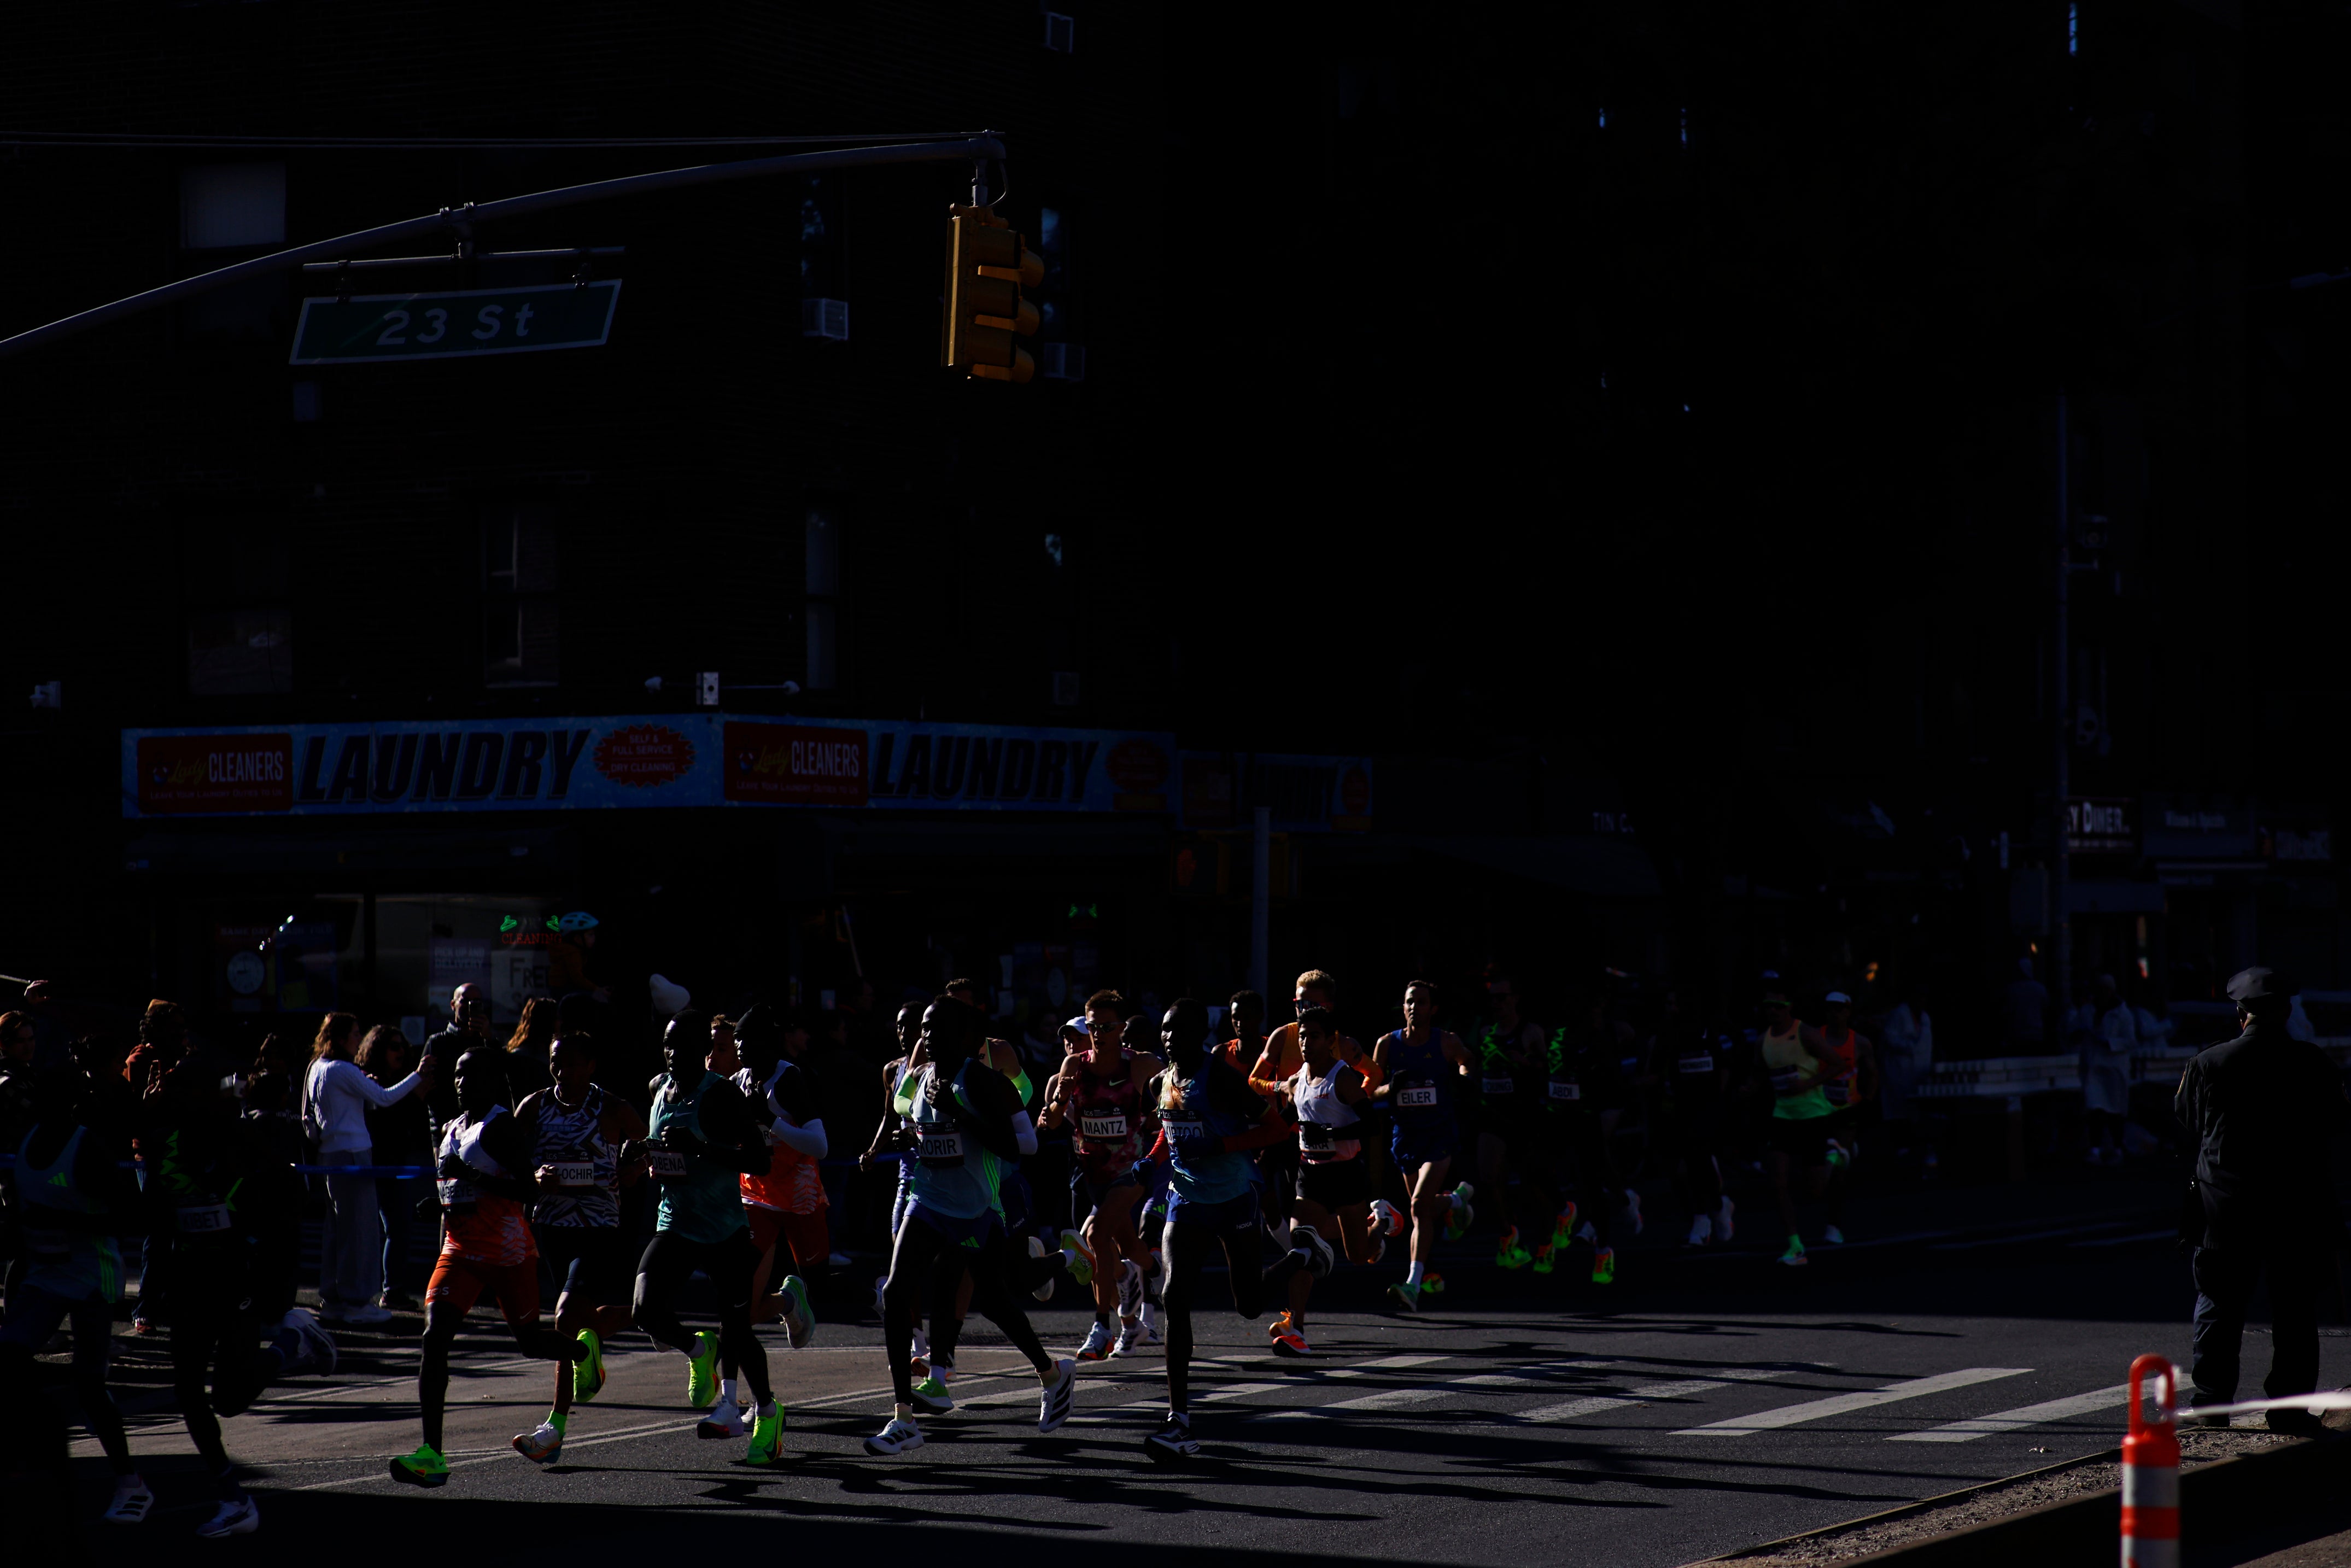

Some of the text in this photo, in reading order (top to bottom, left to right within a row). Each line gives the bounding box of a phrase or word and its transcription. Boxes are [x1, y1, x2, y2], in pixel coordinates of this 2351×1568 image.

[376, 302, 534, 346] 23 St
[629, 734, 651, 744] SELF
[612, 744, 673, 755] FULL SERVICE
[752, 739, 859, 778] Lady CLEANERS
[168, 750, 284, 786] Lady CLEANERS
[294, 729, 591, 803] LAUNDRY
[611, 762, 676, 773] DRY CLEANING
[870, 732, 1100, 799] LAUNDRY
[501, 933, 562, 945] CLEANING
[435, 947, 485, 957] PICK UP AND
[435, 957, 484, 969] DELIVERY
[1401, 1091, 1431, 1104] EILER
[1552, 1085, 1573, 1097] ABDI
[1085, 1120, 1124, 1134] MANTZ
[919, 1139, 957, 1155] KORIR
[651, 1156, 686, 1171] OBENA
[554, 1168, 593, 1179] T-OCHIR
[181, 1210, 220, 1229] KIBET
[1236, 1221, 1253, 1230] HOKA
